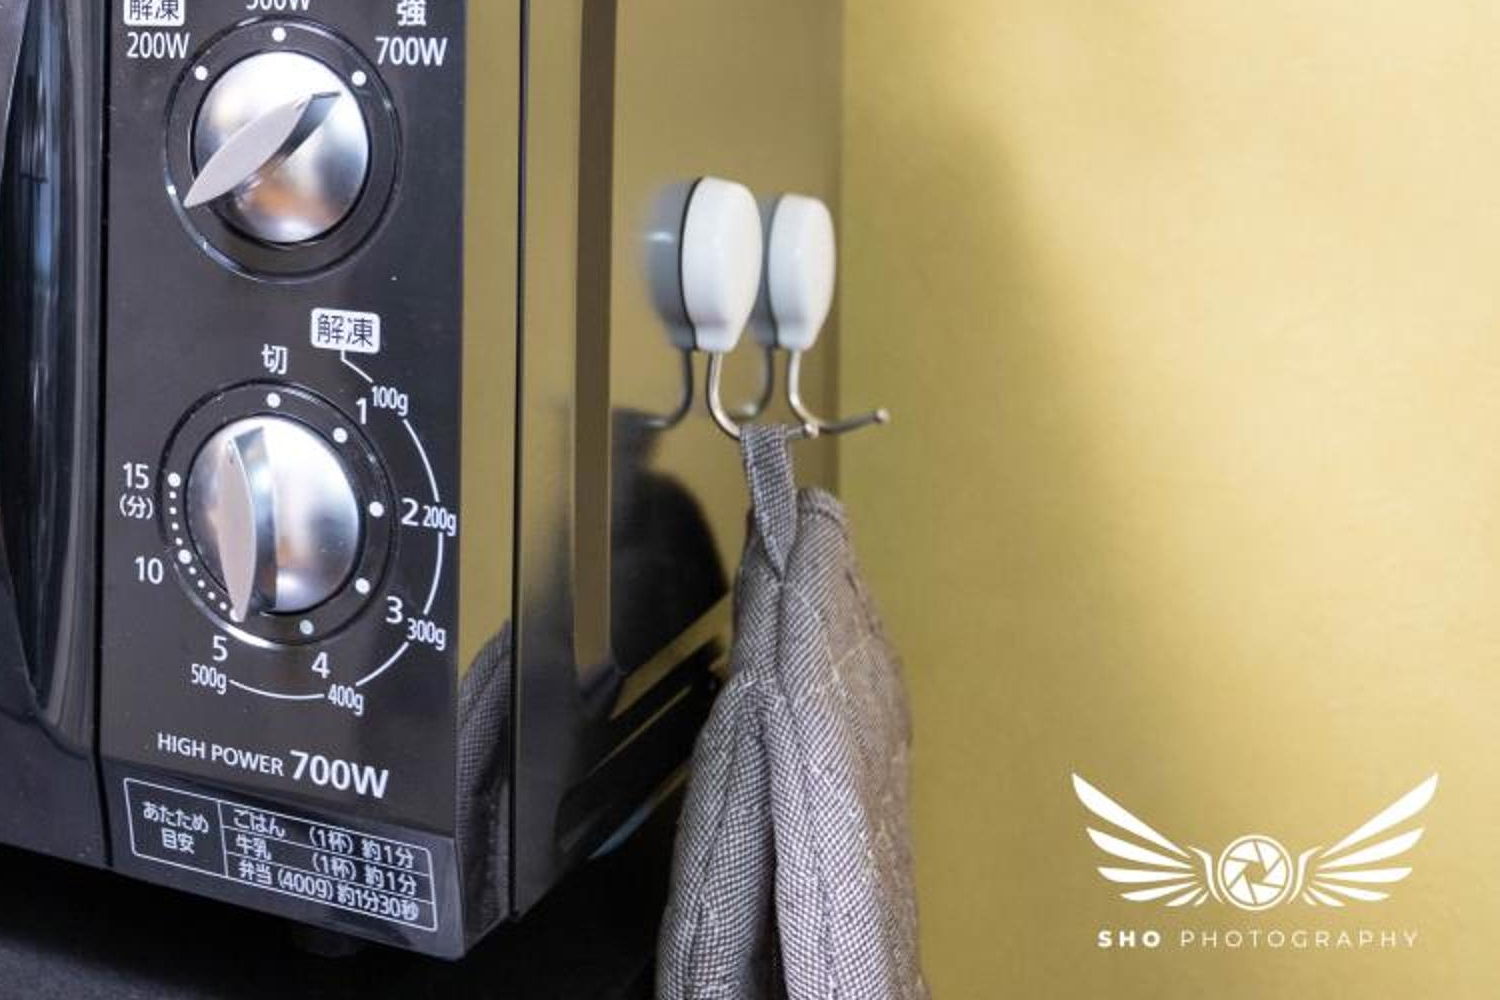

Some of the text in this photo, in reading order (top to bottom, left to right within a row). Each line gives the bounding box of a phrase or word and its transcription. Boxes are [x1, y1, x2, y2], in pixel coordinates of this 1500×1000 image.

[126, 31, 190, 59] 200W
[375, 37, 448, 66] 700W
[318, 314, 373, 347] 解凍
[261, 344, 288, 375] 切
[356, 397, 367, 424] 1
[372, 386, 408, 417] 100g
[122, 462, 150, 490] 15
[401, 498, 419, 526] 2
[422, 508, 456, 536] 200g
[135, 556, 164, 584] 10
[386, 596, 403, 624] 3
[406, 617, 446, 651] 300g
[212, 636, 228, 662] 5
[191, 664, 227, 694] 500g
[312, 651, 330, 679] 4
[328, 685, 364, 716] 400g
[157, 732, 389, 799] HIGH POWER 700W
[142, 801, 209, 833] あたため
[234, 808, 286, 838] ごはん
[161, 827, 195, 855] 目安
[236, 833, 272, 861] 牛乳
[239, 859, 272, 885] 弁当
